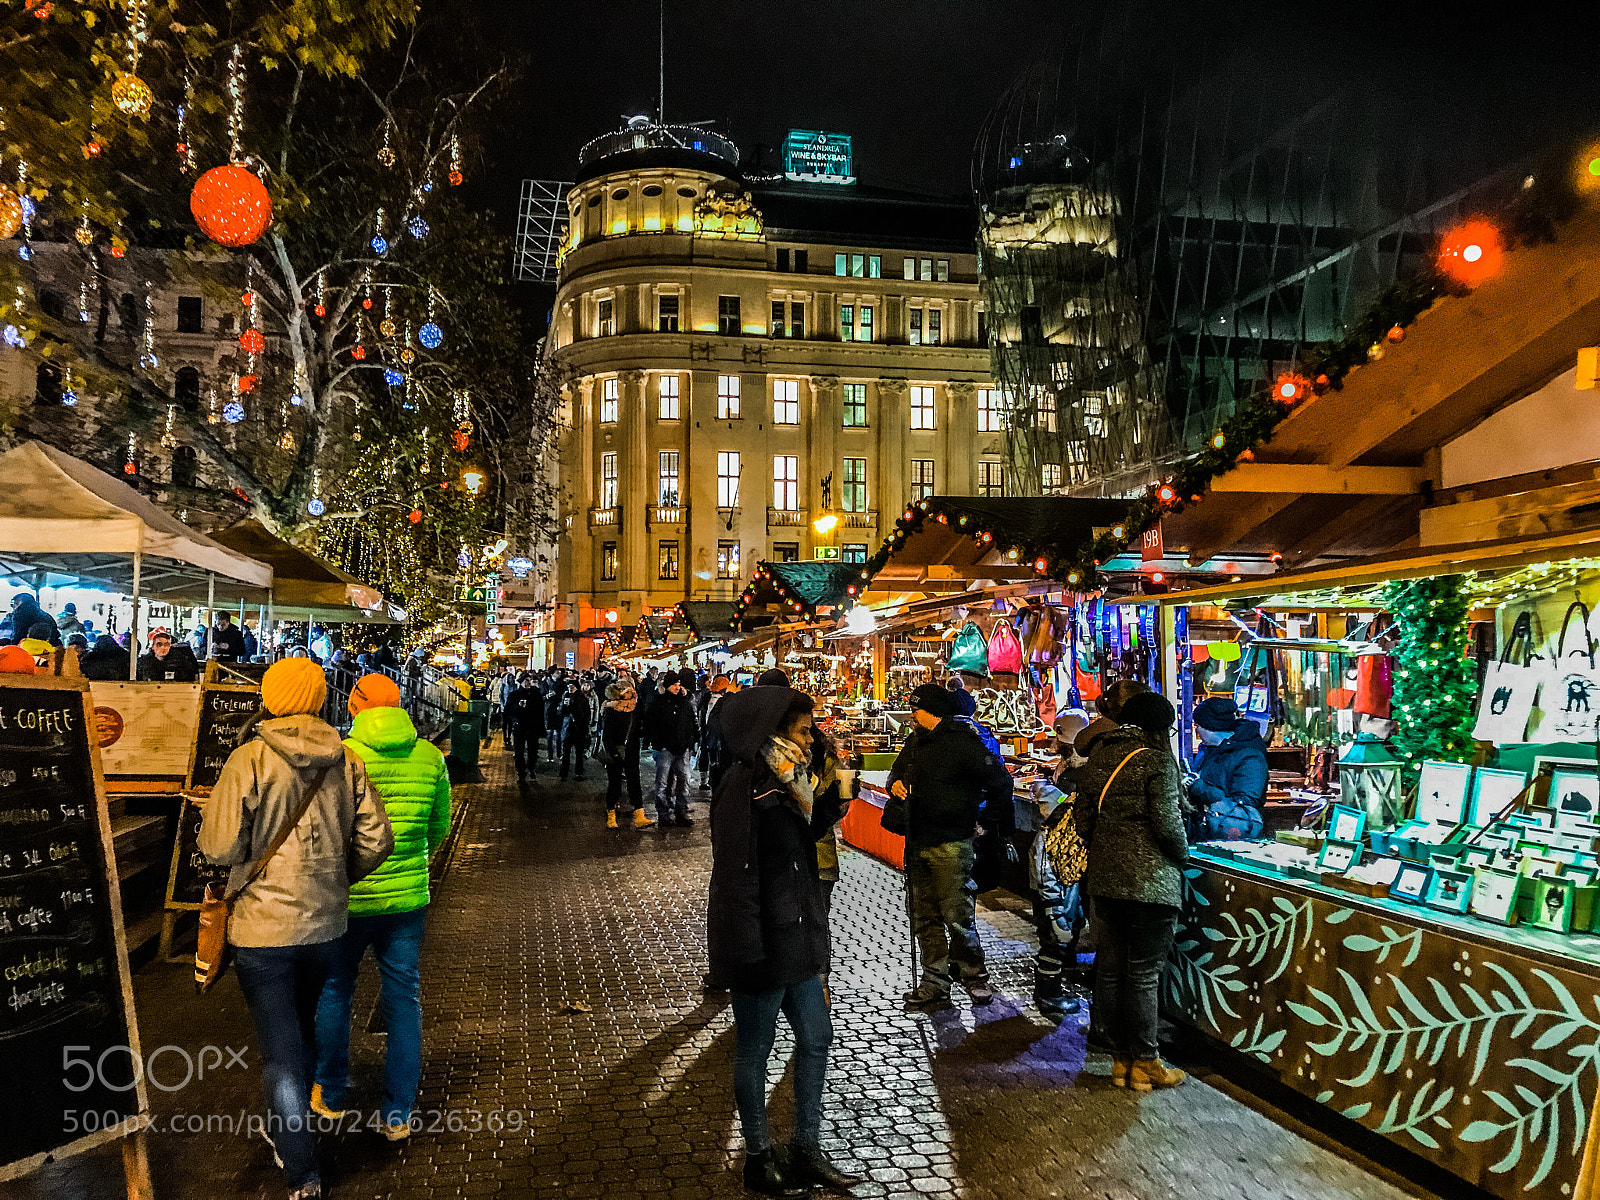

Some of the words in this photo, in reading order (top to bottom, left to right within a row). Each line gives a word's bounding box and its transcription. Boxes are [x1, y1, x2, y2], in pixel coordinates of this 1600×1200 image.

[790, 150, 810, 160] WINE
[1143, 529, 1159, 549] 19B
[17, 708, 73, 734] COFFEE
